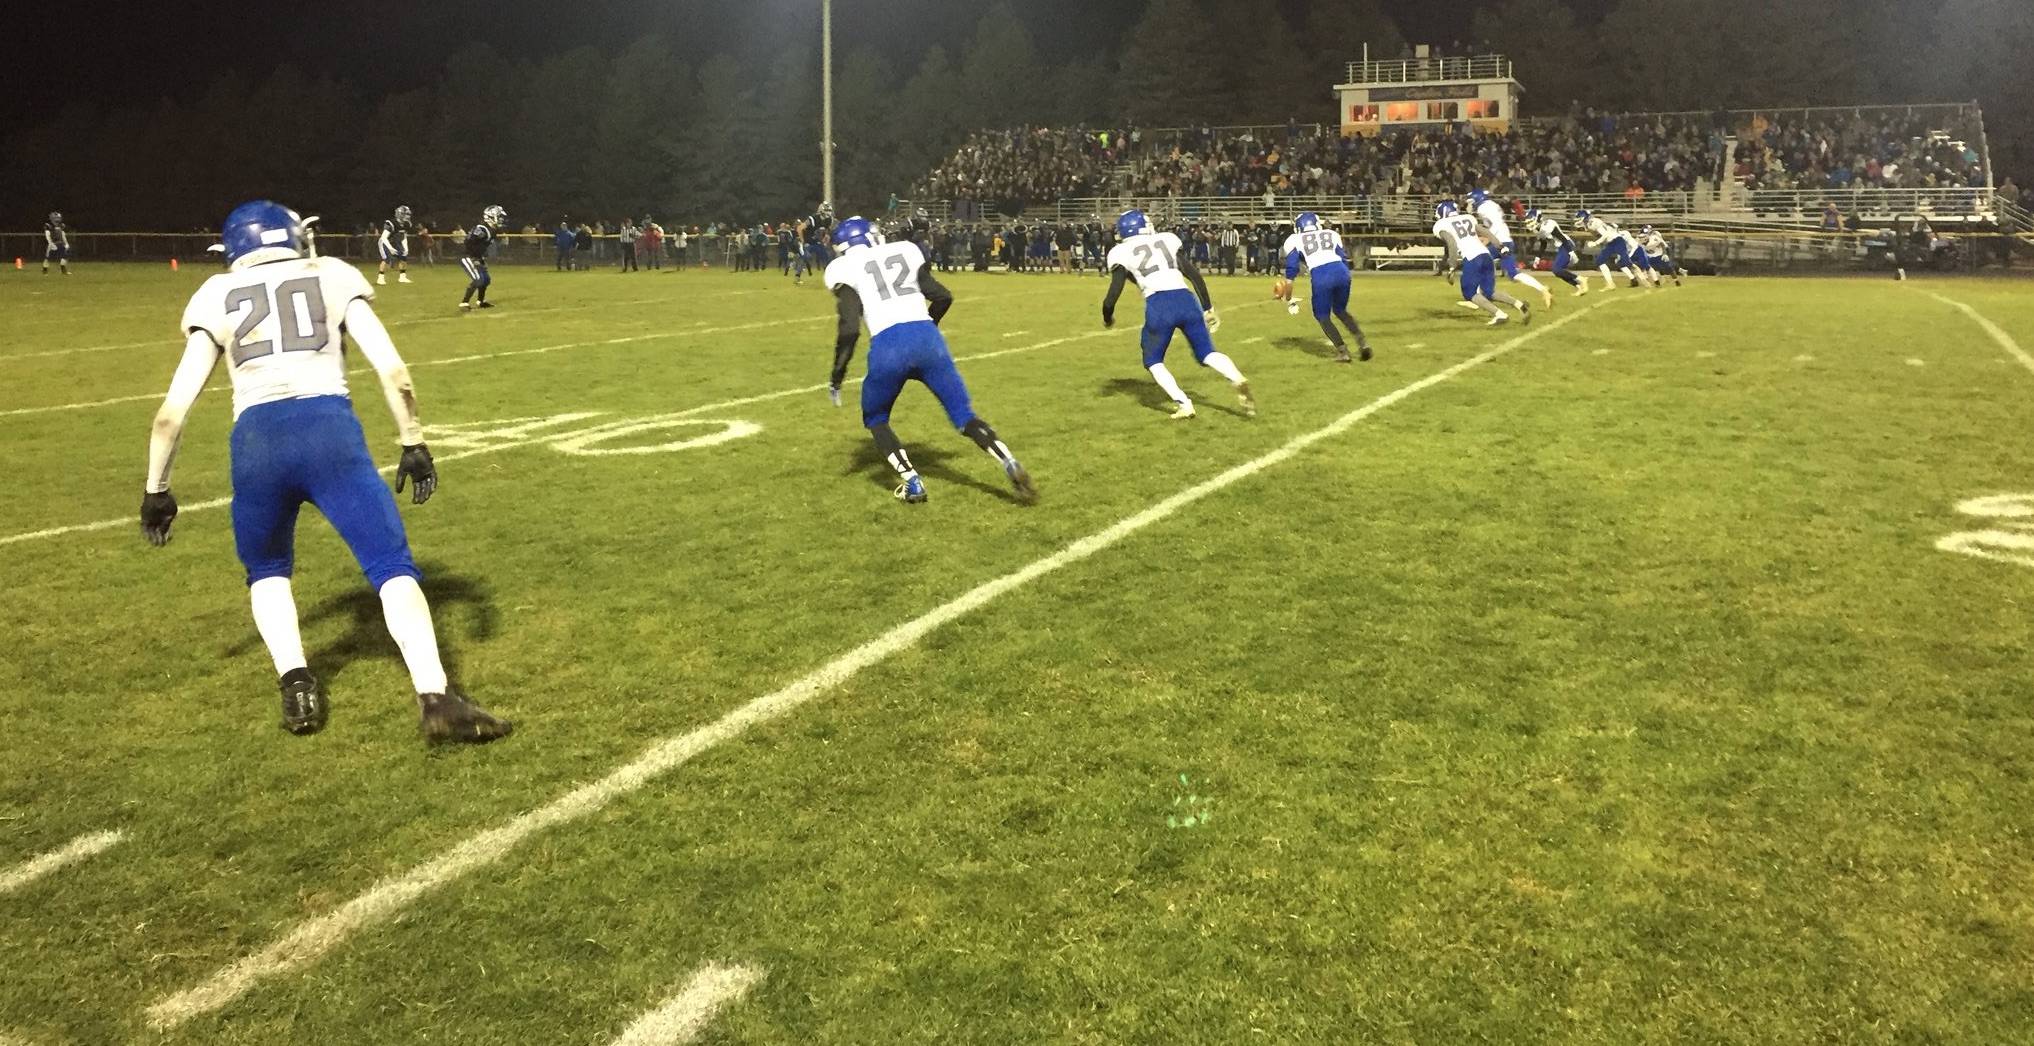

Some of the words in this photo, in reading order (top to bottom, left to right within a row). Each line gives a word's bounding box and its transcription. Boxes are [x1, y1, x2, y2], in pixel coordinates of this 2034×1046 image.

[1302, 232, 1334, 256] 88
[1452, 219, 1476, 239] 62
[864, 253, 919, 300] 12
[1132, 239, 1178, 277] 21
[225, 276, 329, 368] 20
